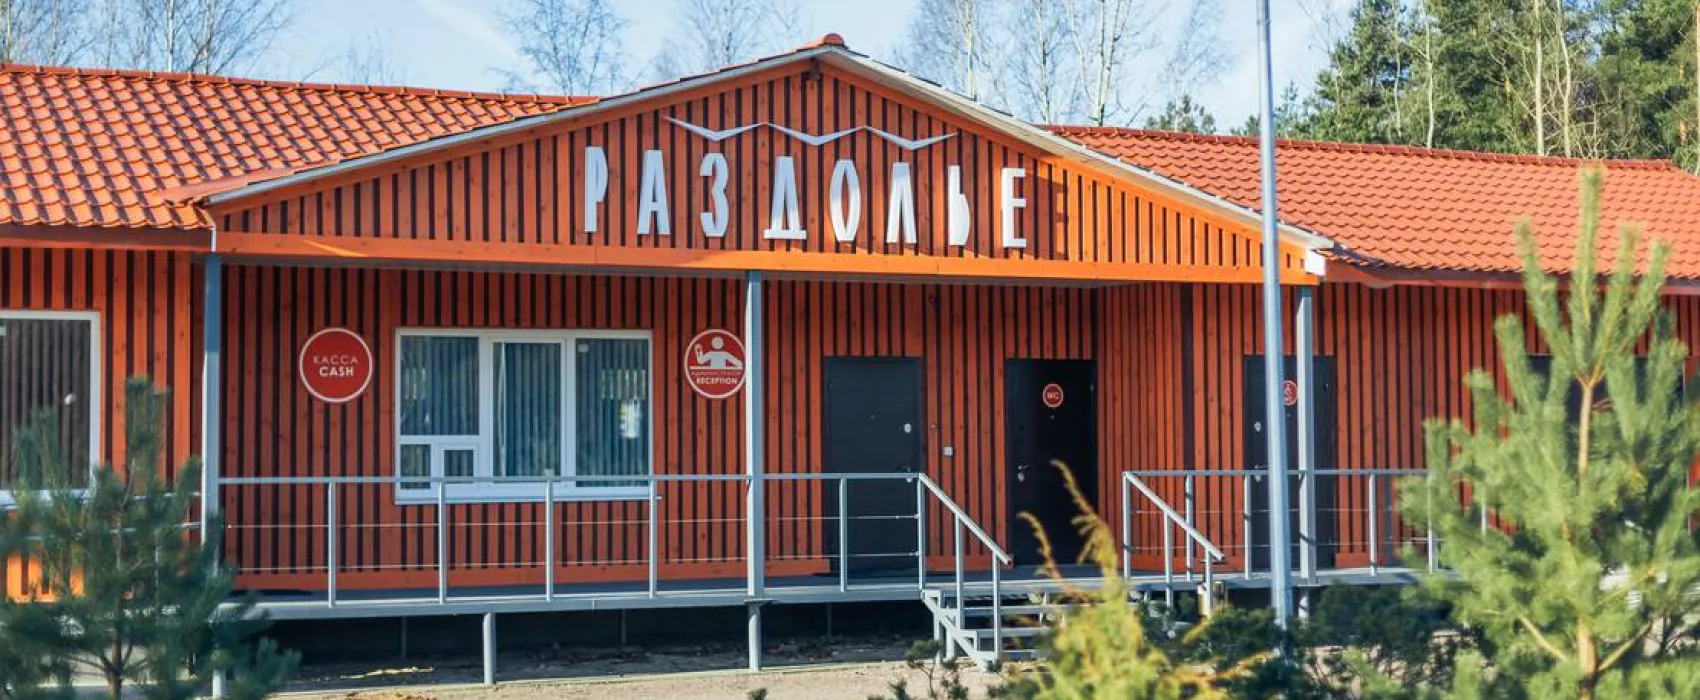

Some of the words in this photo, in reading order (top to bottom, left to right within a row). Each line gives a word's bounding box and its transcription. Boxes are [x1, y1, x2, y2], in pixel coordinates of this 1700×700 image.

[584, 146, 1027, 248] РАЗДОЛЬЕ
[313, 355, 358, 365] КАССА
[319, 366, 354, 377] CASH
